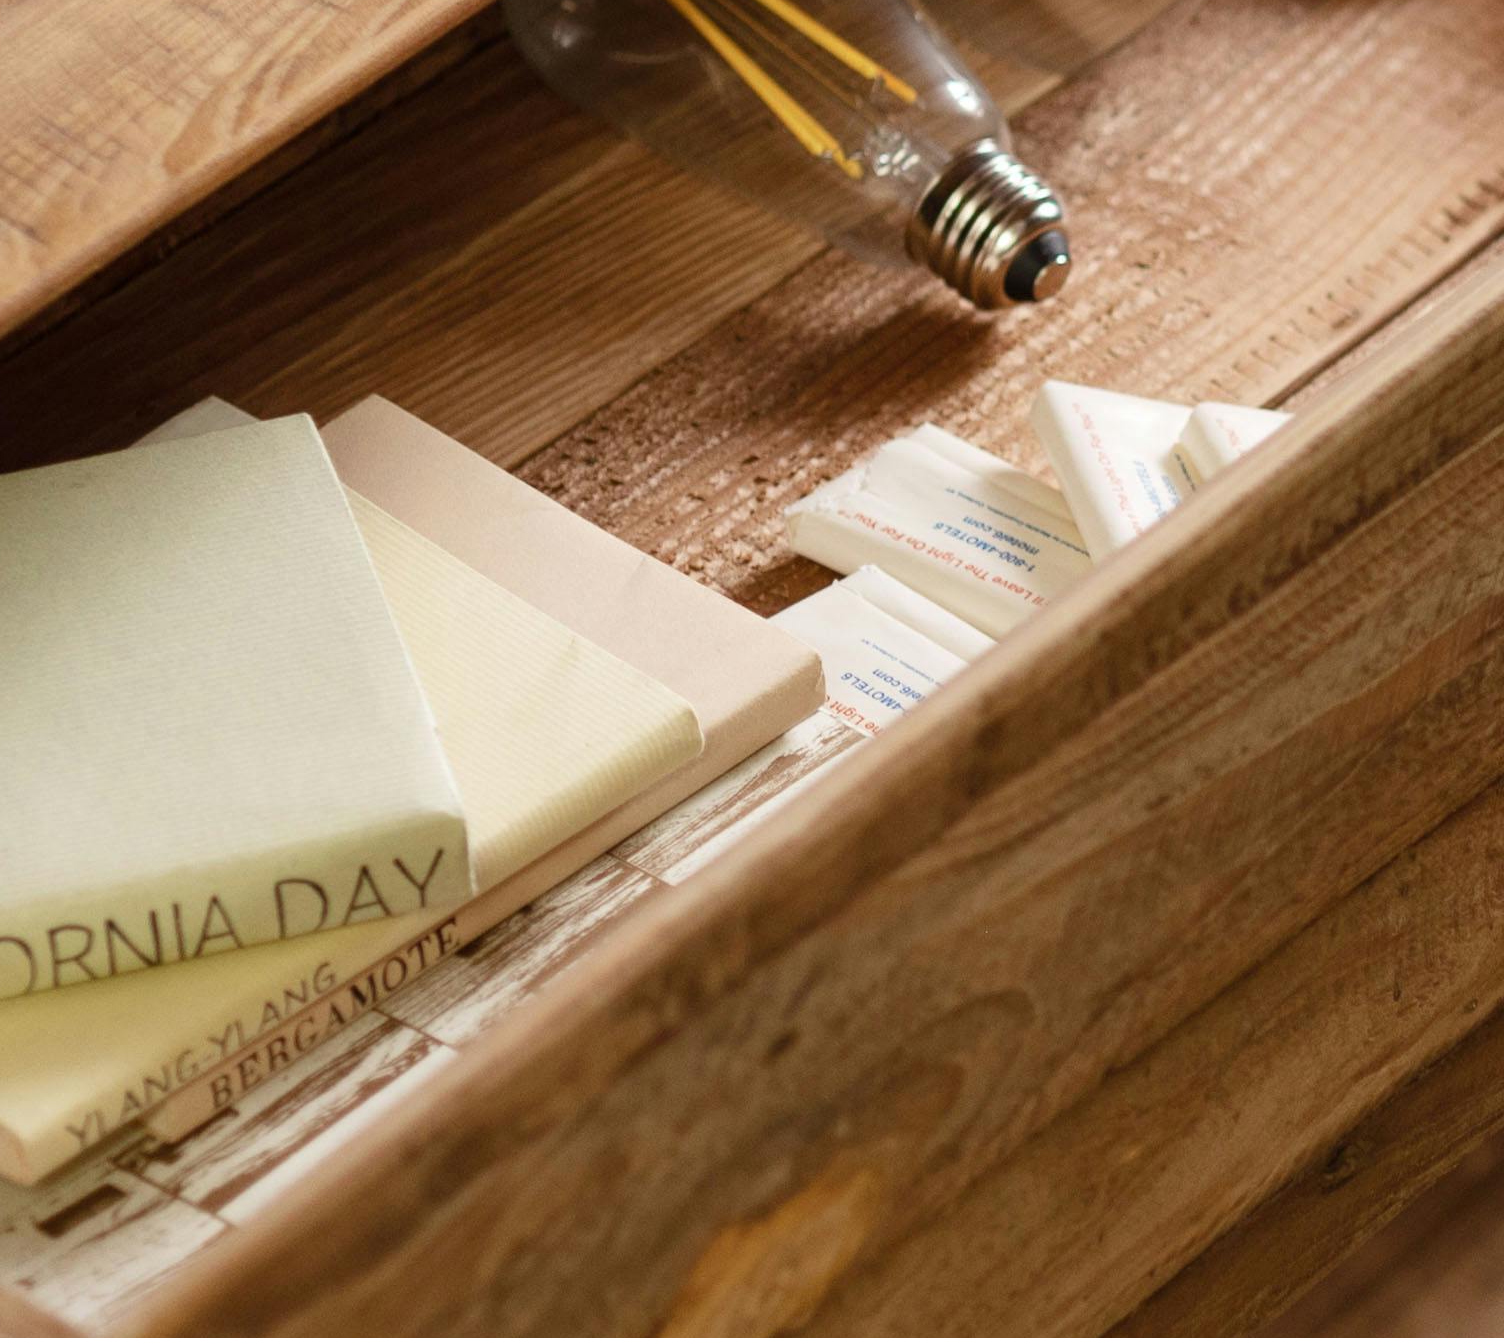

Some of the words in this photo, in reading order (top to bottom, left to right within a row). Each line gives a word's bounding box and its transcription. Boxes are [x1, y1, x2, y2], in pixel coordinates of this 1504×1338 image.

[881, 526, 905, 541] For
[906, 537, 926, 550] On
[927, 546, 963, 568] Light
[965, 564, 990, 582] The
[992, 576, 1033, 600] Leave
[872, 668, 927, 703] tel6.com
[829, 701, 864, 726] Light
[273, 847, 445, 941] DAY
[208, 916, 461, 1111] BERGAMOTE
